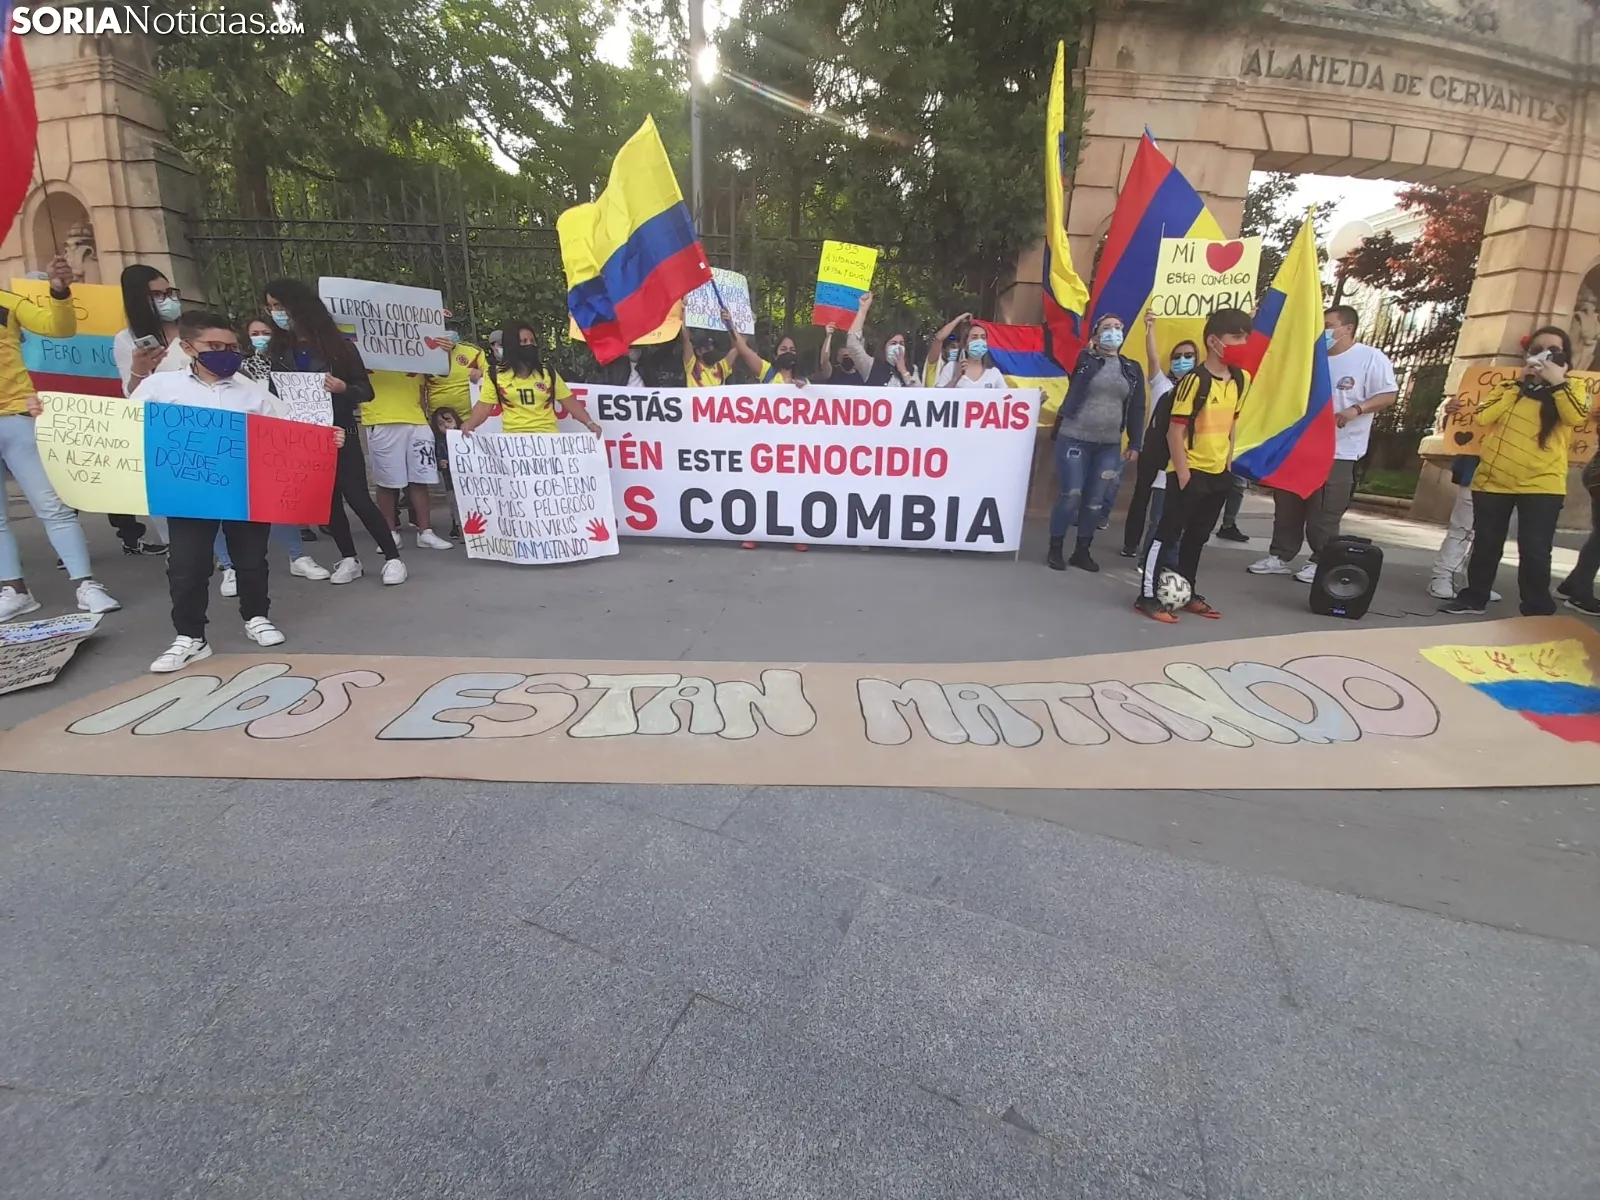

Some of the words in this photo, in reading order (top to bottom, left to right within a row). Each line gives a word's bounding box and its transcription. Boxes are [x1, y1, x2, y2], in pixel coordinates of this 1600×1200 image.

[1242, 48, 1385, 93] ALAMEDA
[1392, 72, 1423, 96] DE
[1429, 73, 1568, 127] CERVANTES
[386, 303, 443, 327] COLORADO
[1150, 290, 1254, 318] COLOMBIA
[361, 319, 421, 342] ESTAMOS
[41, 339, 82, 365] PERO
[362, 334, 425, 357] CONTIGO
[42, 395, 115, 417] PORQUE
[121, 406, 145, 423] ME
[517, 388, 535, 406] 10
[149, 402, 246, 432] PORQUE
[597, 391, 683, 423] ESTÁS
[692, 396, 892, 428] MASACRANDO
[900, 400, 921, 428] A
[926, 400, 960, 428] MI
[964, 394, 1030, 431] PAÍS
[53, 413, 110, 434] ESTAN
[167, 429, 207, 453] SE
[217, 436, 246, 460] DE
[497, 435, 548, 458] PUEBLO
[551, 435, 597, 457] MARCHA
[605, 432, 663, 471] TÉN
[677, 448, 743, 473] ESTE
[750, 443, 948, 478] GENOCIDIO
[48, 448, 60, 462] A
[66, 449, 112, 468] ALZAR
[116, 458, 144, 473] MI
[155, 446, 220, 471] DONDE
[456, 455, 472, 474] EN
[478, 456, 510, 477] PLENA
[512, 456, 564, 478] PANDEMIA
[568, 457, 580, 475] ES
[67, 469, 102, 484] VOZ
[171, 465, 230, 487] VENGO
[459, 476, 504, 497] PORQUE
[509, 480, 528, 499] SU
[534, 475, 597, 497] GOBIERNO
[498, 500, 526, 518] MAS
[533, 494, 596, 518] PELIGROSO
[679, 487, 1005, 544] COLOMBIA
[498, 517, 518, 537] QUE
[541, 515, 578, 538] VIRUS
[66, 662, 385, 739] NOS
[376, 669, 819, 741] ESTAN
[857, 655, 1441, 749] MATANDO
